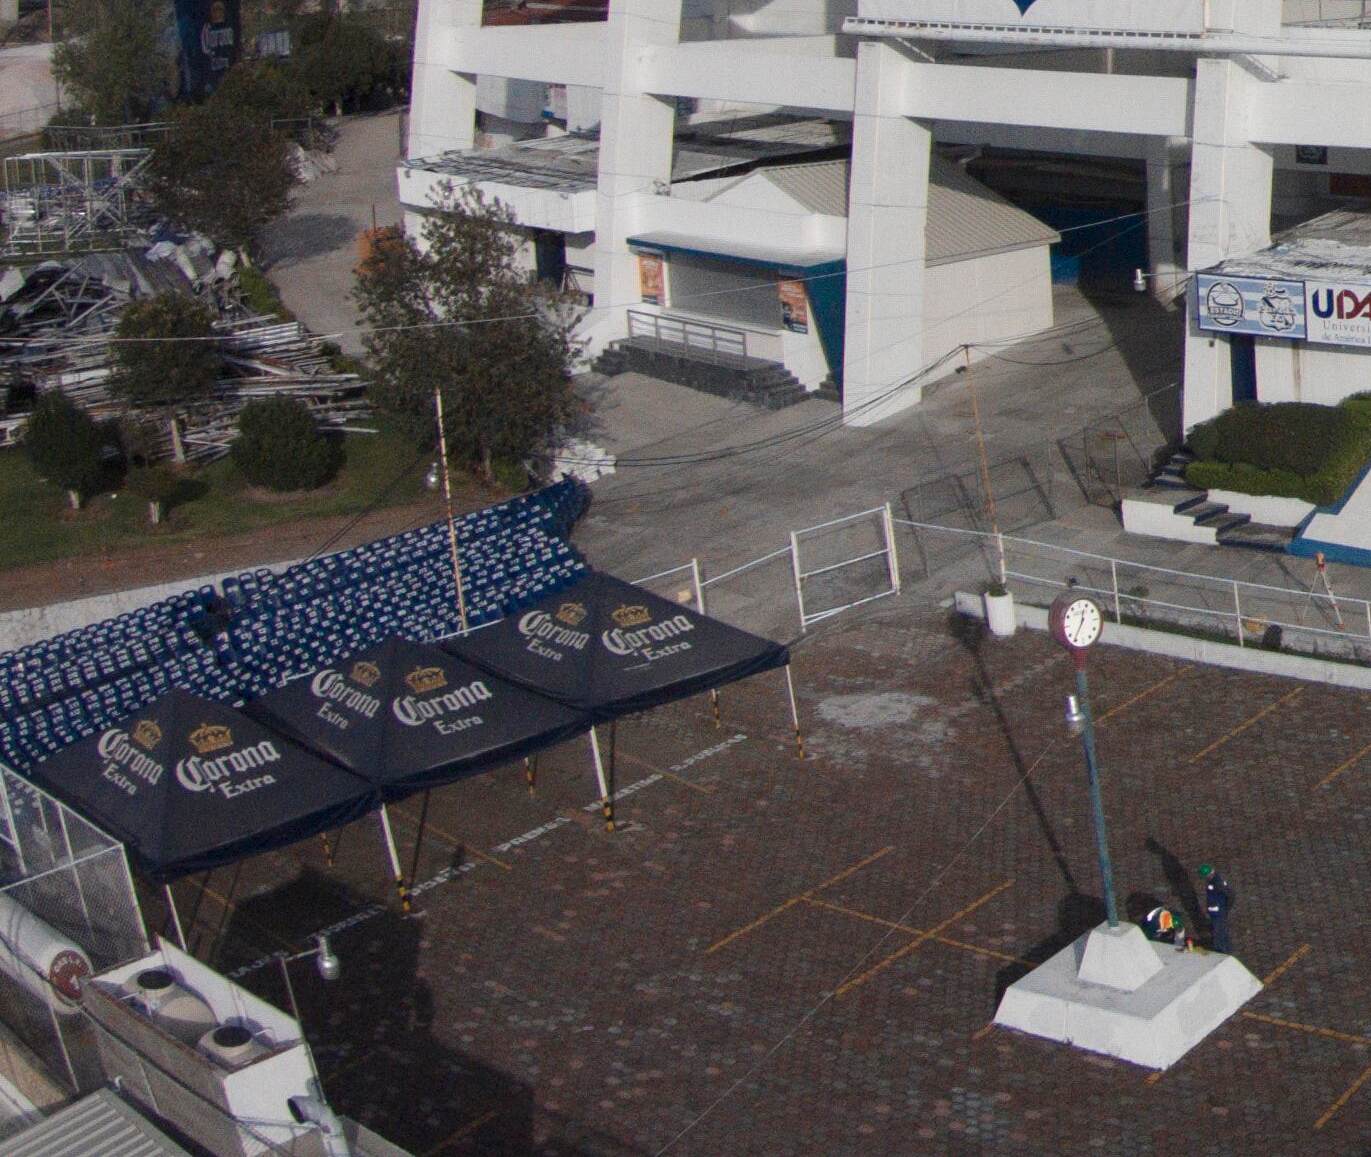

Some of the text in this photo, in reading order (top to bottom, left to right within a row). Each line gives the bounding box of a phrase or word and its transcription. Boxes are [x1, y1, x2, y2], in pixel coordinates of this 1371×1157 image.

[518, 610, 590, 650] Corona
[602, 613, 694, 655] Corona
[526, 638, 563, 662] Extra
[645, 640, 692, 661] Extra
[311, 668, 380, 719] Corona
[392, 679, 493, 726] Corona
[316, 702, 349, 730] Extra
[432, 714, 484, 735] Extra
[98, 728, 164, 785] Corona
[175, 741, 281, 791] Corona
[102, 762, 137, 795] Extra
[218, 772, 277, 799] Extra
